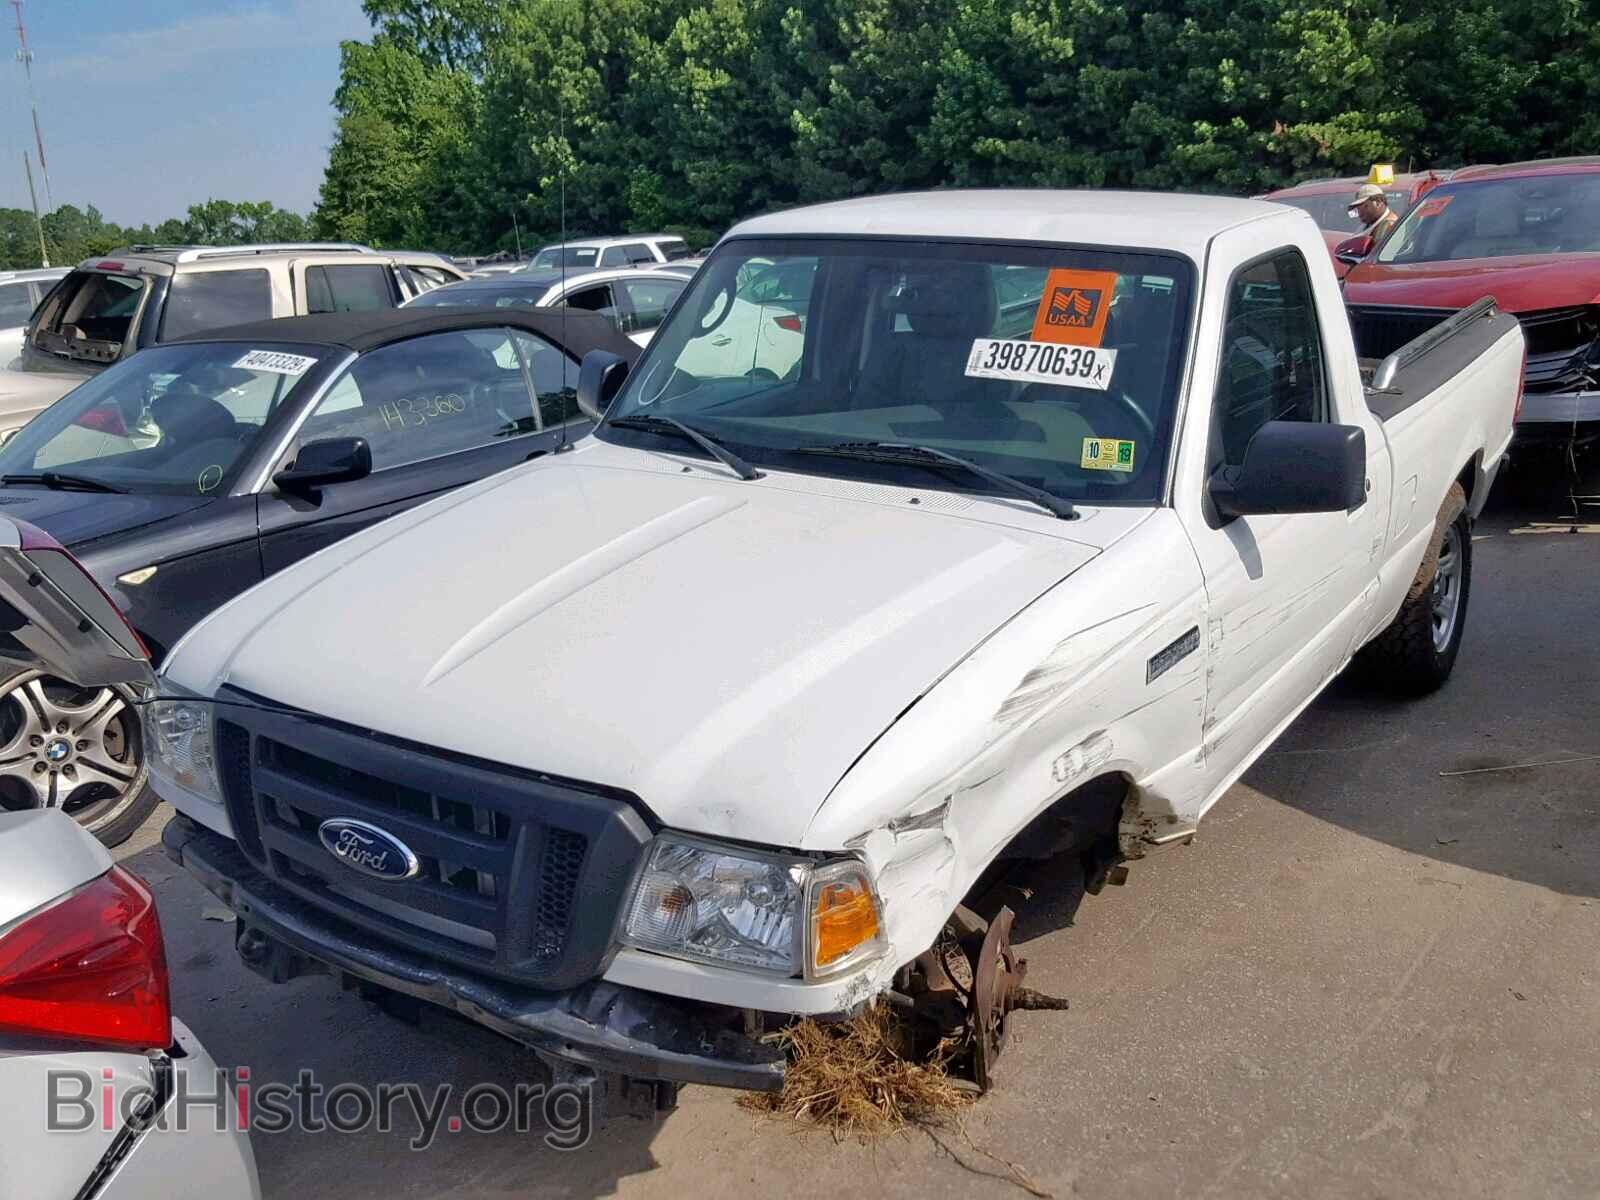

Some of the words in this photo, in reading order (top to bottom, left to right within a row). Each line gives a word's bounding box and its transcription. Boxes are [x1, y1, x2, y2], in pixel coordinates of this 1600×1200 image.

[1048, 313, 1087, 326] USAA
[983, 341, 1096, 378] 39870639
[1088, 441, 1099, 459] 10
[335, 828, 389, 871] Ford
